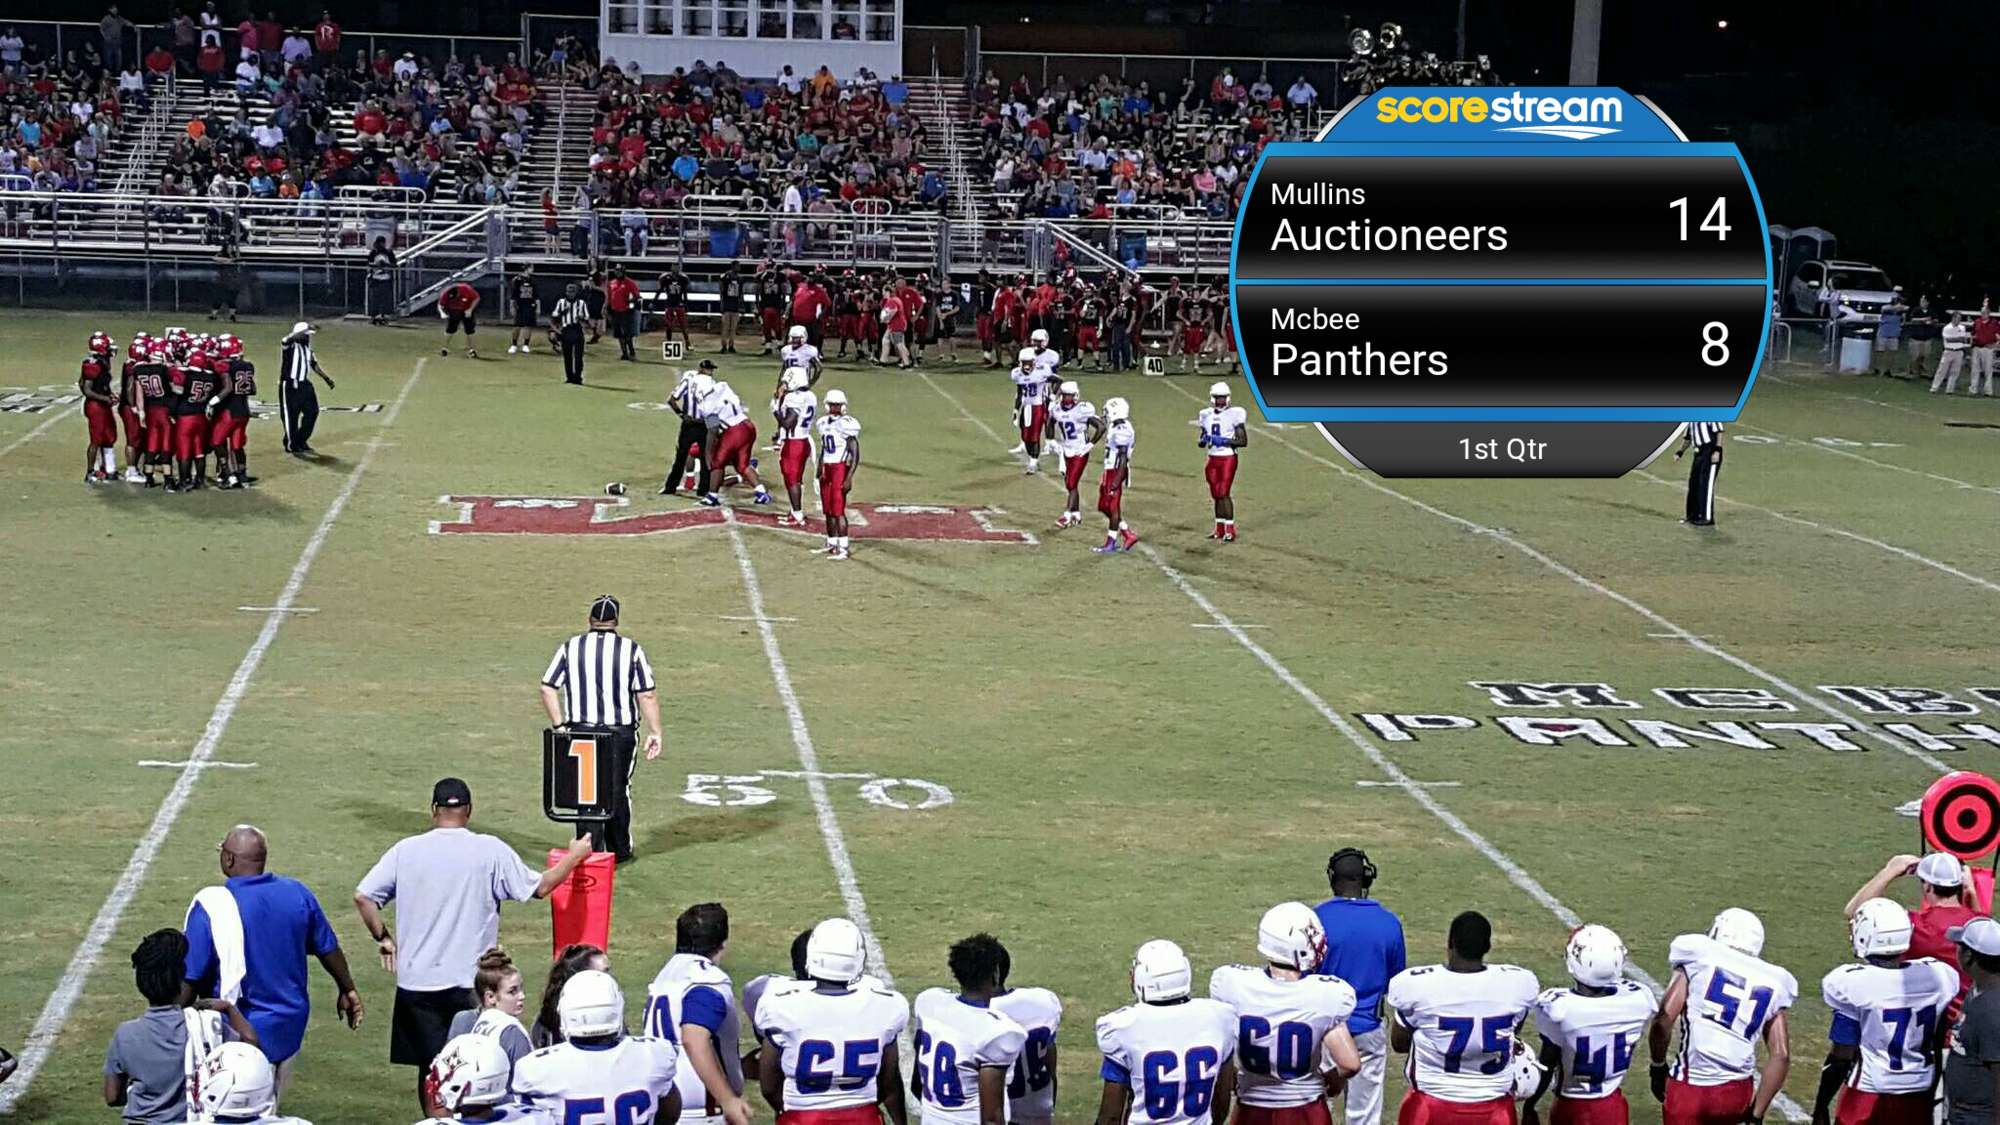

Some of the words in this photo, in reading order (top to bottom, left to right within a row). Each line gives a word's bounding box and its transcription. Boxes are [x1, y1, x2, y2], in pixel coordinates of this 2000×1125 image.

[664, 343, 681, 358] 50
[1146, 359, 1163, 374] 40
[137, 374, 165, 398] 50
[1058, 421, 1078, 440] 12
[1467, 680, 2000, 716] MCB
[568, 738, 598, 805] 1
[680, 773, 955, 810] 50
[1703, 966, 1774, 1041] 51
[798, 1038, 880, 1095] 65
[1238, 1014, 1313, 1080] 60
[1438, 1013, 1514, 1075] 75
[1882, 1003, 1937, 1071] 71
[917, 1030, 966, 1108] 68
[1143, 1044, 1219, 1121] 66
